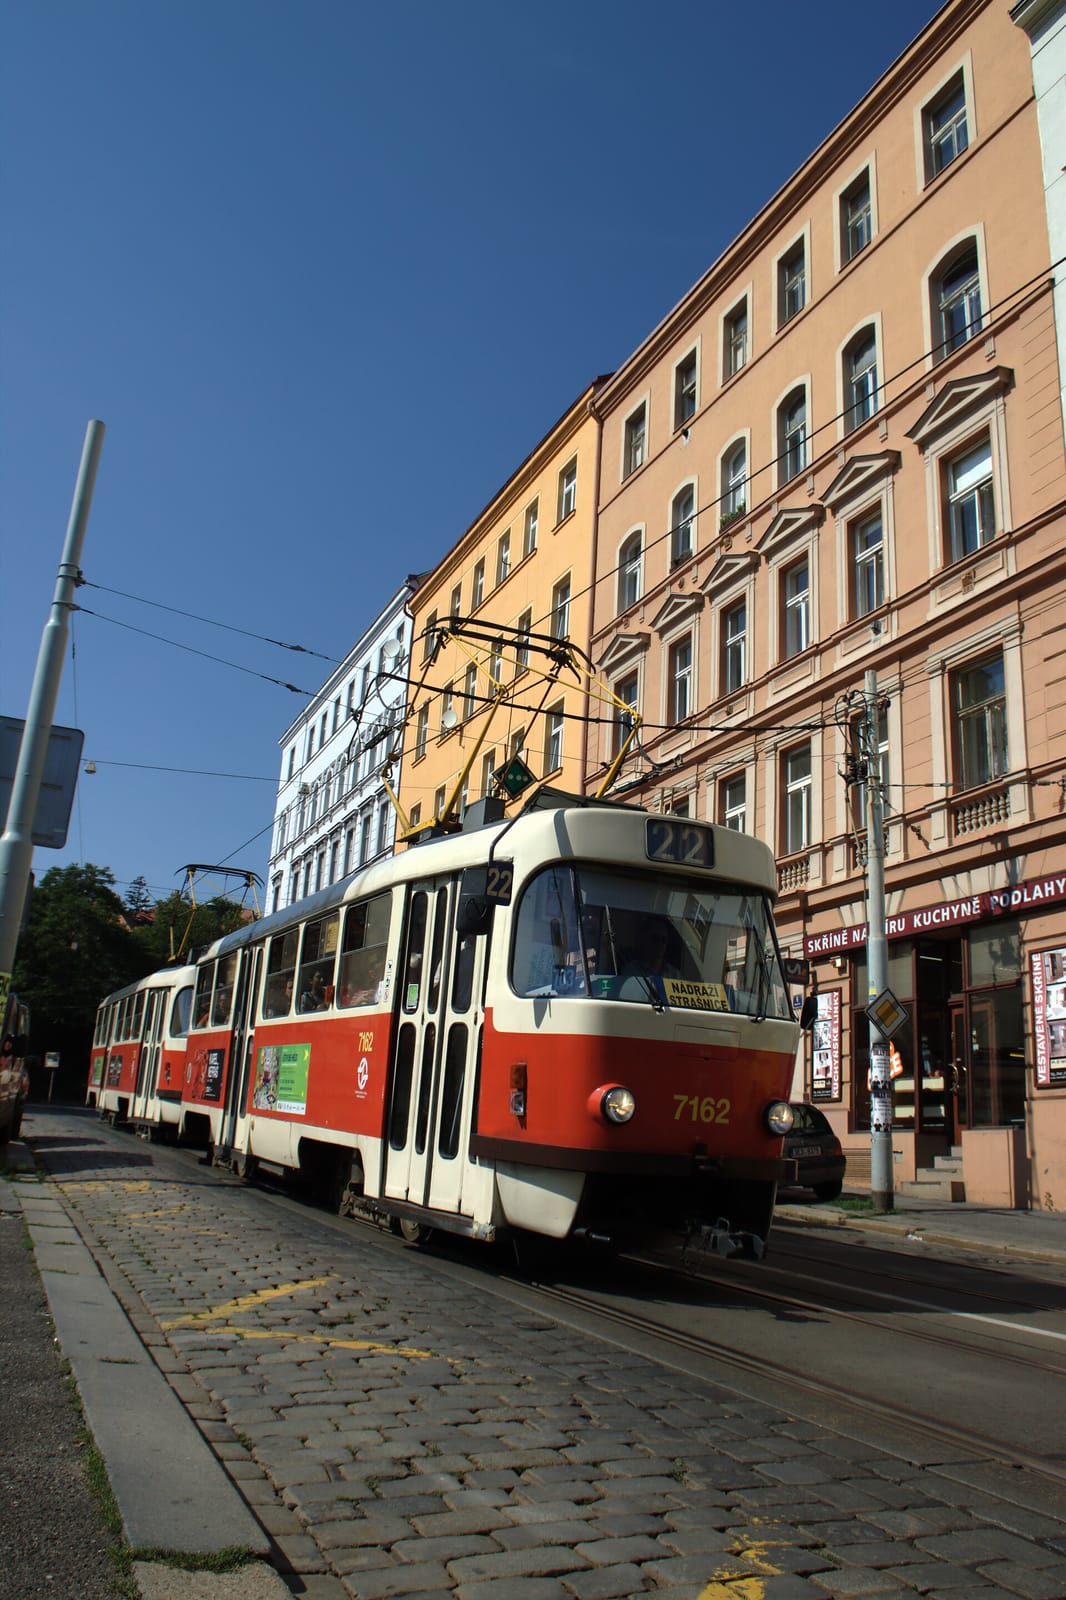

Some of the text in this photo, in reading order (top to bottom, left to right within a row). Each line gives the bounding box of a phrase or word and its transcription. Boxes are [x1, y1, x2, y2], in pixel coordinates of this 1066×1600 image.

[651, 823, 705, 865] 22
[486, 867, 512, 899] 22
[807, 929, 848, 953] SKŘÍNĚ
[852, 927, 867, 943] NA
[912, 899, 981, 929] KUCHYNĚ
[990, 877, 1066, 911] PODLAHY
[669, 994, 729, 1011] STRAŠNICE
[671, 981, 719, 998] NÁDRAŽÍ
[358, 1031, 374, 1053] 7162
[673, 1094, 732, 1125] 7162
